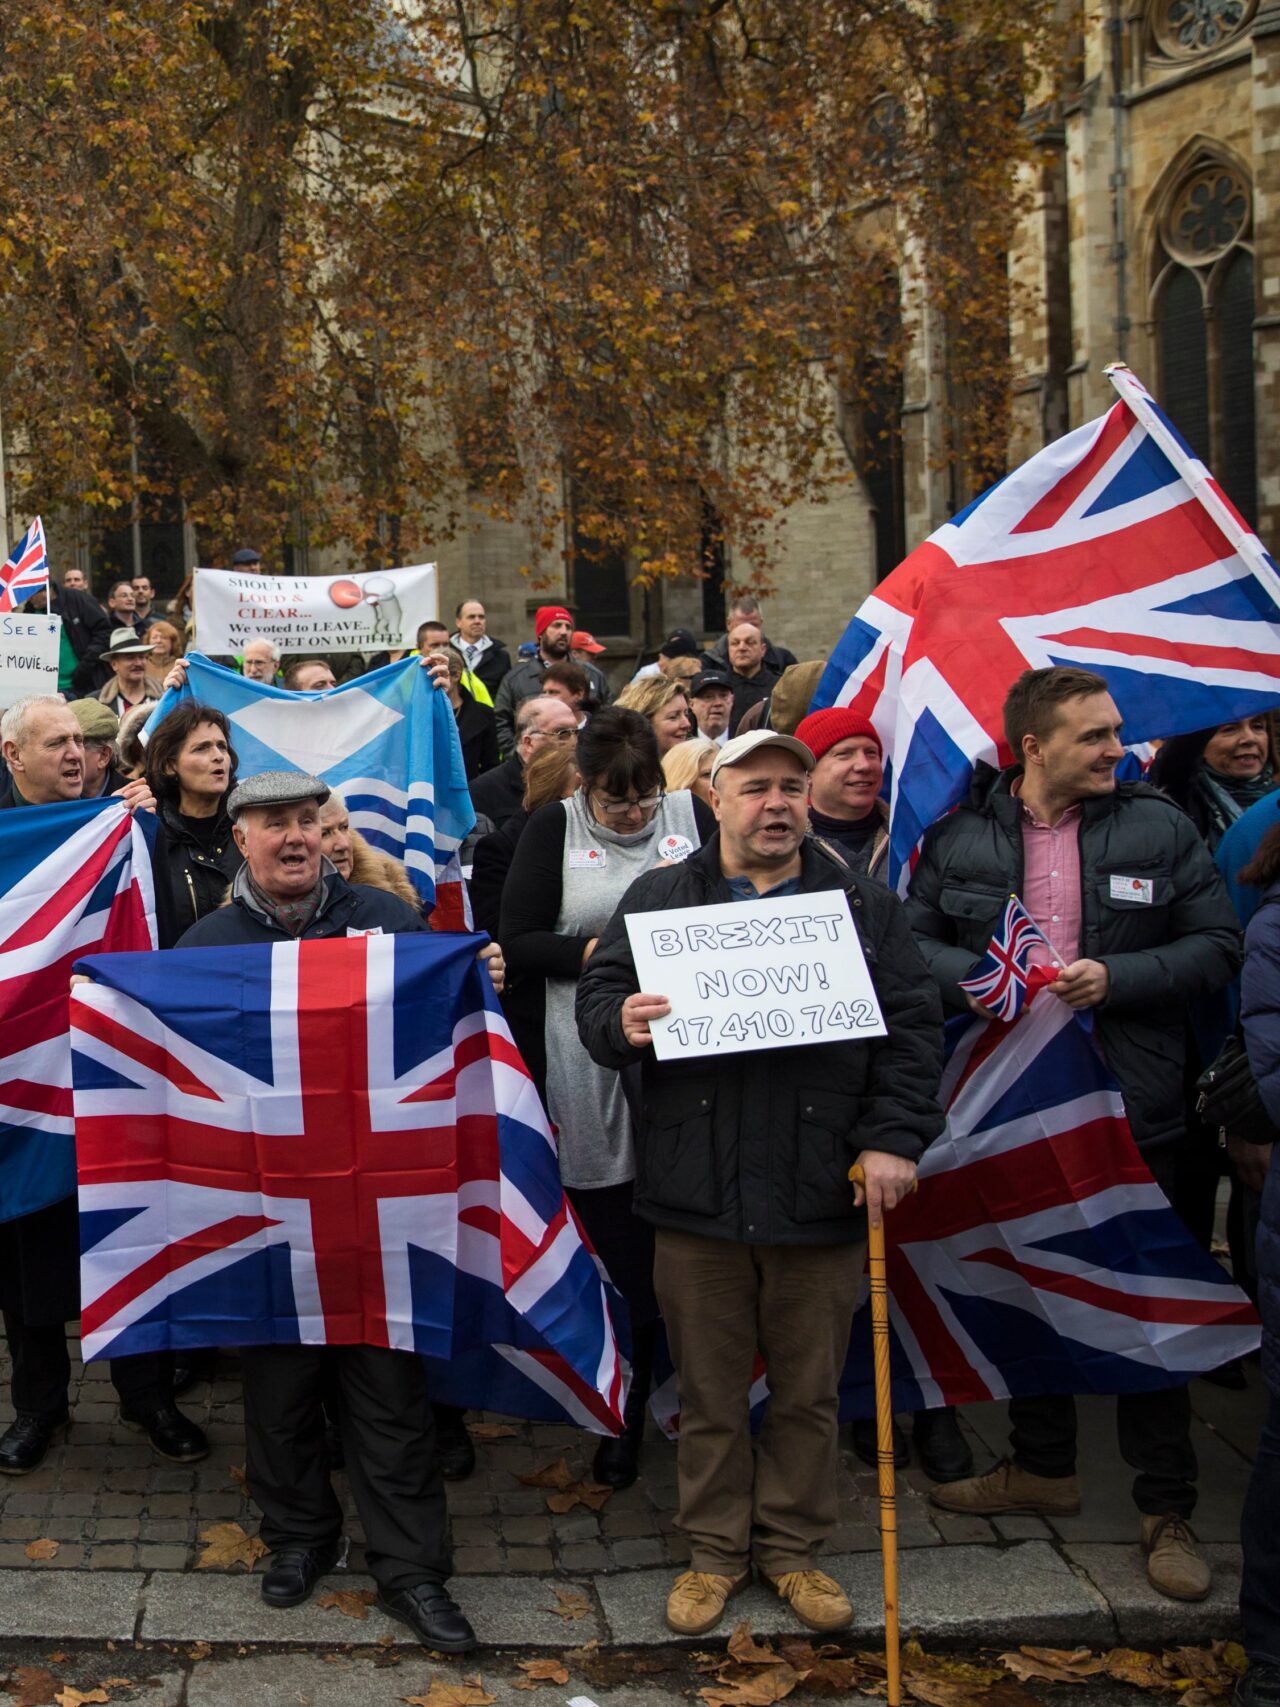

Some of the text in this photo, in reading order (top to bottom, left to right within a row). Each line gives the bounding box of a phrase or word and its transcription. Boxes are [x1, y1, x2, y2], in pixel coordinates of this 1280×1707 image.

[228, 578, 309, 591] SHOUT IT
[238, 592, 304, 603] LOUD &
[238, 607, 312, 619] CLEAR...
[228, 623, 251, 633] We
[255, 623, 292, 633] voted
[295, 624, 309, 633] to
[308, 635, 331, 647] ON
[335, 633, 377, 645] WITH
[669, 842, 690, 855] Voted
[650, 914, 844, 958] BREXIT
[695, 962, 830, 999] NOW!
[667, 998, 879, 1047] 17,410,742
